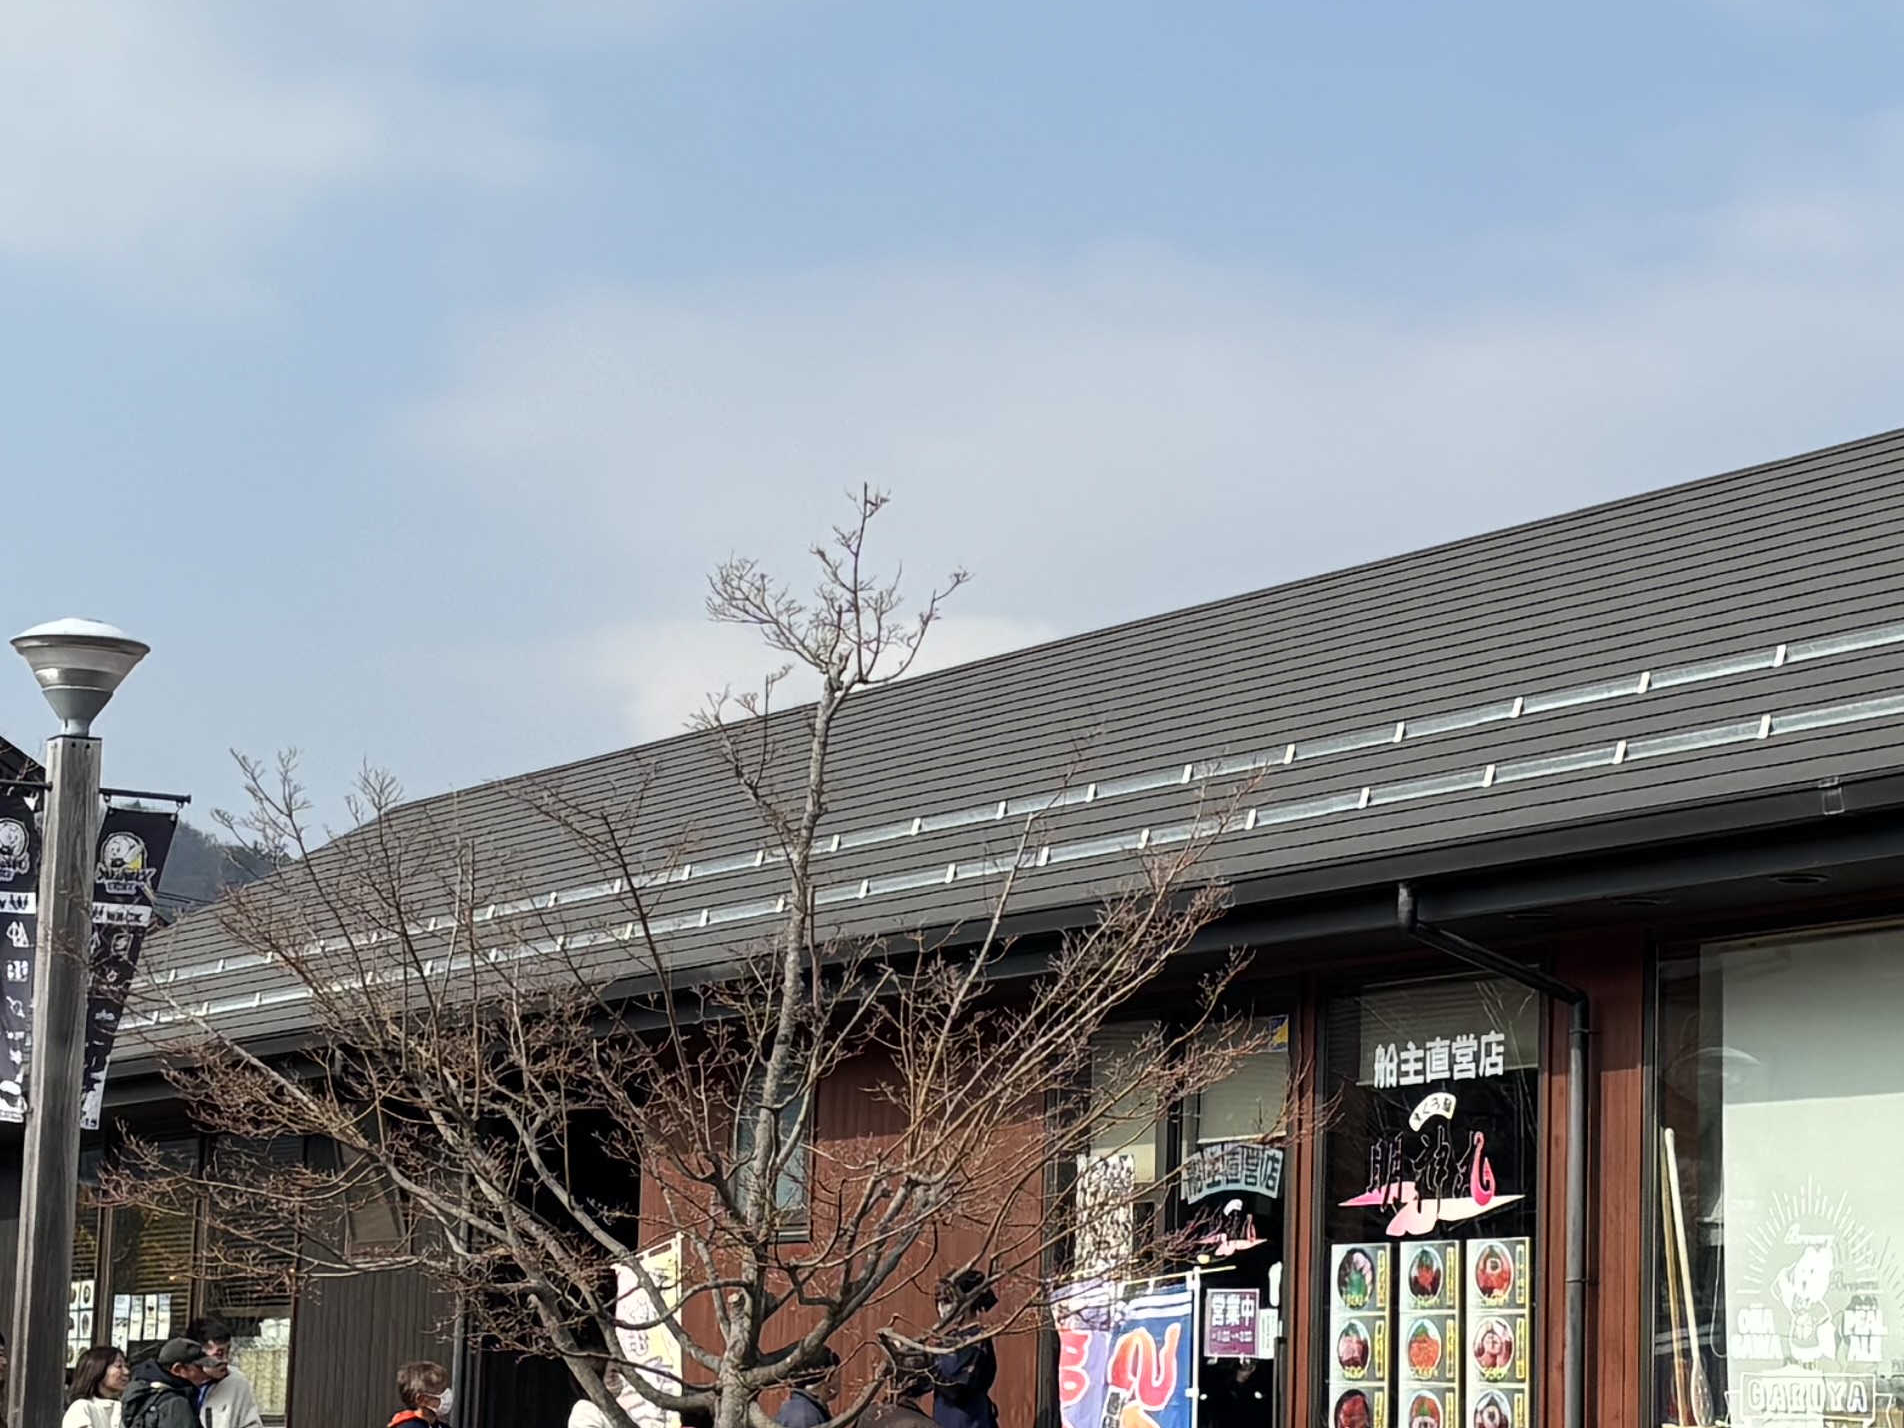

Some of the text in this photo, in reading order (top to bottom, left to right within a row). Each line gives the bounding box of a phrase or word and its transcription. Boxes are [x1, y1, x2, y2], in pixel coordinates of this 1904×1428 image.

[1374, 1030, 1505, 1089] 船主直営店
[1747, 1380, 1868, 1413] GARUYA
